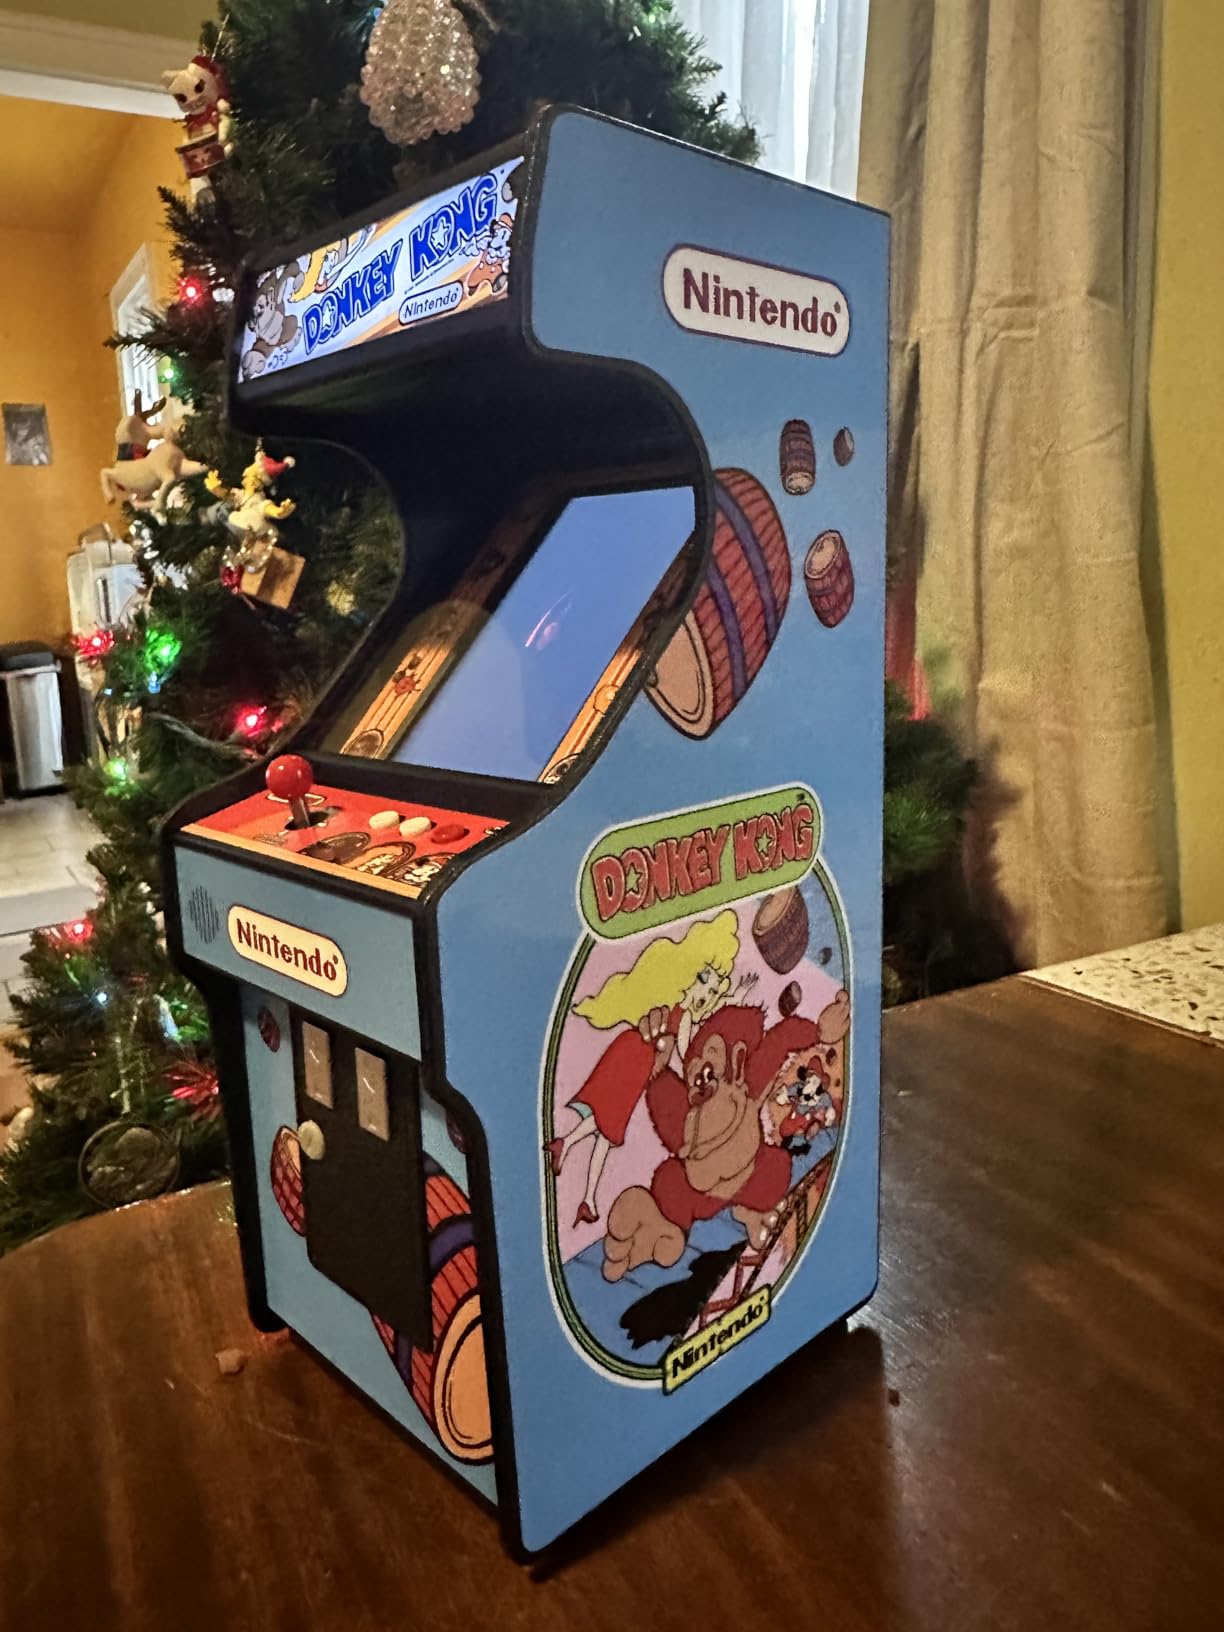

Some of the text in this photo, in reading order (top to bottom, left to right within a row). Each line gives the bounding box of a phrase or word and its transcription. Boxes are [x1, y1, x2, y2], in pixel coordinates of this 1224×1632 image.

[302, 172, 498, 355] DONKEY KONG
[683, 267, 838, 338] Nintendo
[591, 803, 814, 922] DONKEY KONG
[236, 917, 338, 982] Nintendo
